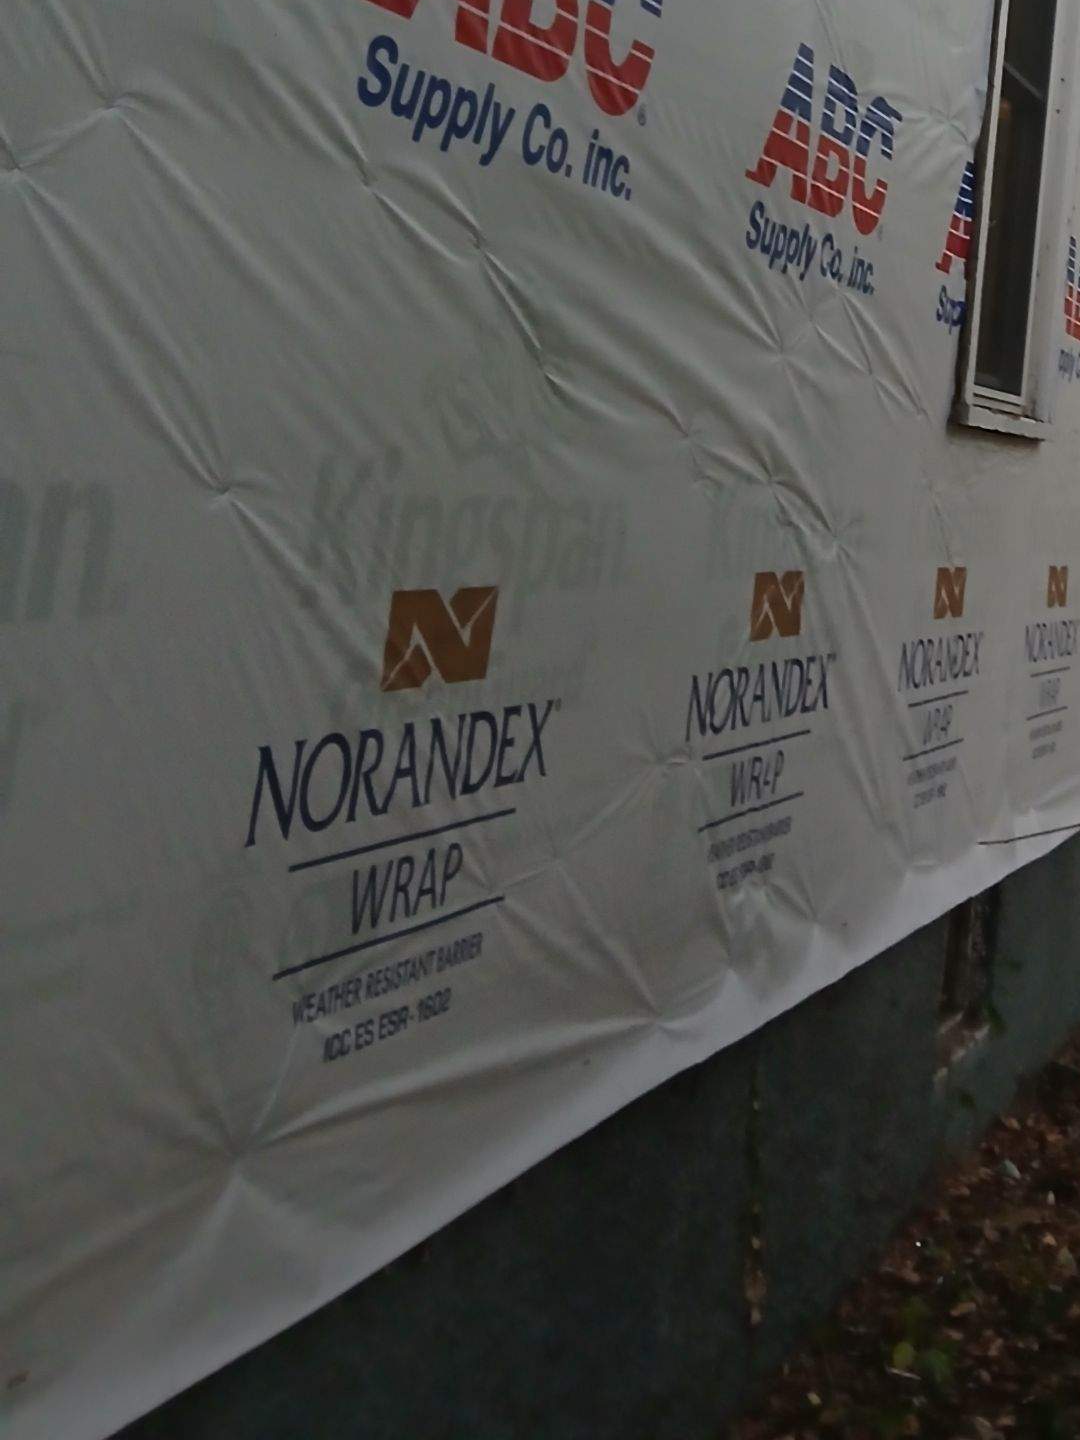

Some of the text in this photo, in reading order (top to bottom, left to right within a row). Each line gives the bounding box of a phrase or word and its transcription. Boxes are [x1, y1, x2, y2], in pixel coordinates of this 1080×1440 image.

[357, 34, 516, 167] Supply
[522, 103, 573, 179] Co.
[744, 41, 904, 236] ABC
[744, 200, 818, 283] Supply
[686, 654, 832, 743] NORANDEX
[897, 632, 981, 693] NORANDEX
[245, 700, 556, 849] NORANDEX
[351, 842, 464, 935] WRAP
[292, 978, 363, 1026] WEATHER
[322, 1027, 352, 1062] ICC
[354, 1017, 375, 1051] ES
